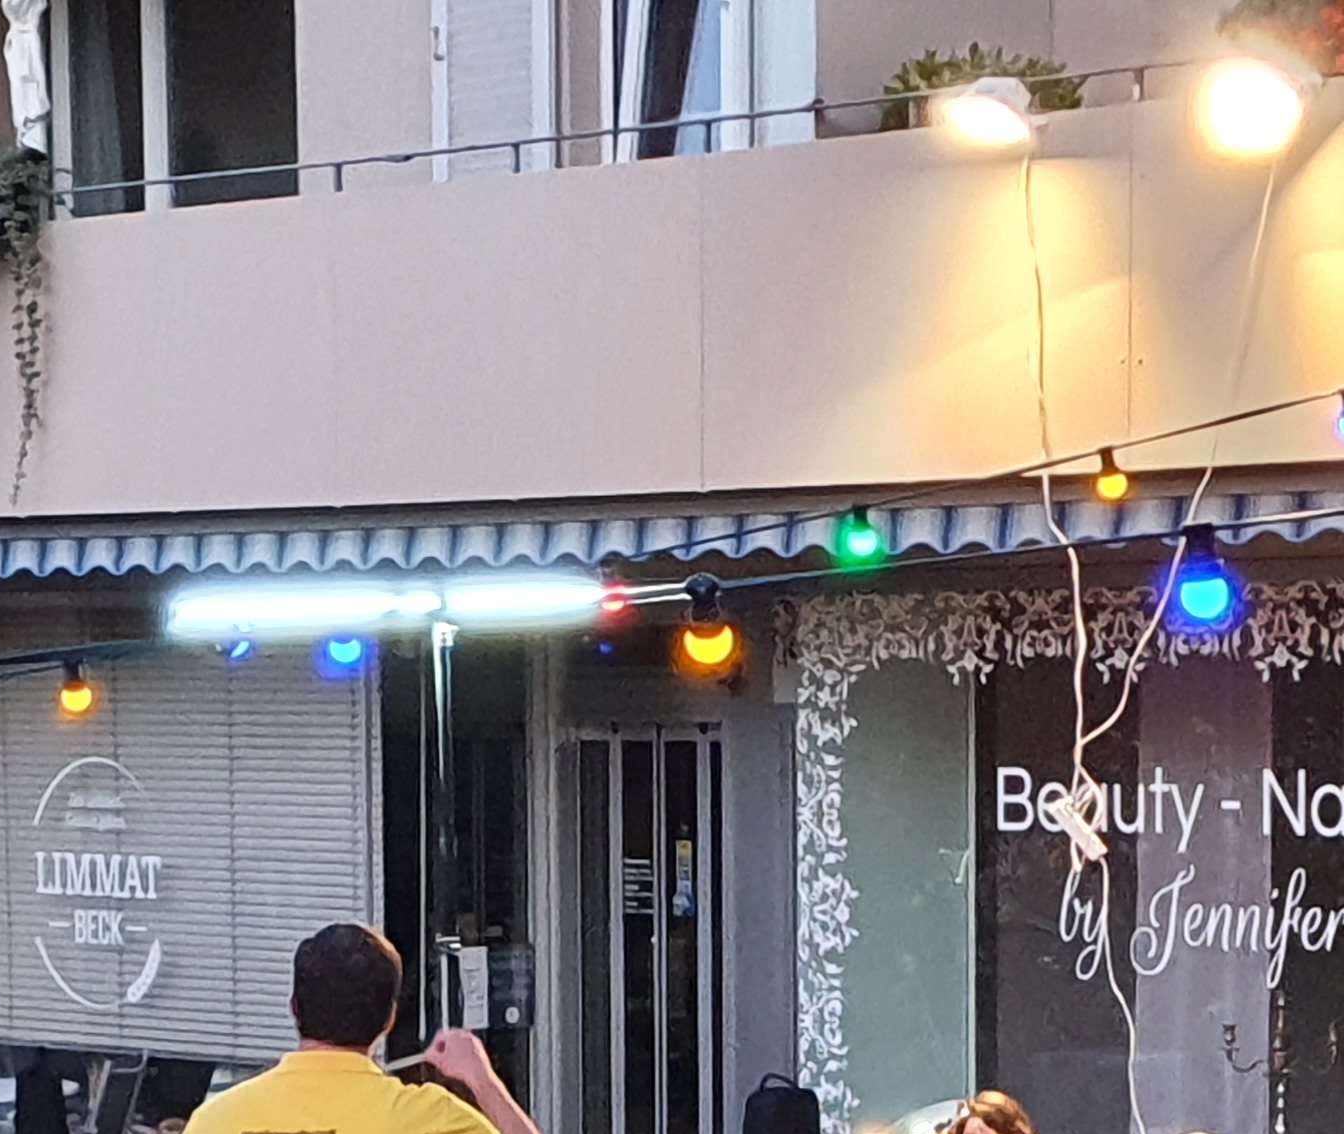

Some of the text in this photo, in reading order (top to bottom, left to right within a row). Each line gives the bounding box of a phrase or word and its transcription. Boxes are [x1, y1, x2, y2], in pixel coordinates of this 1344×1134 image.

[996, 766, 1205, 854] Beauty
[1220, 800, 1241, 811] -
[34, 851, 162, 899] LIMMAT
[74, 908, 125, 945] BECK
[1059, 866, 1107, 981] by
